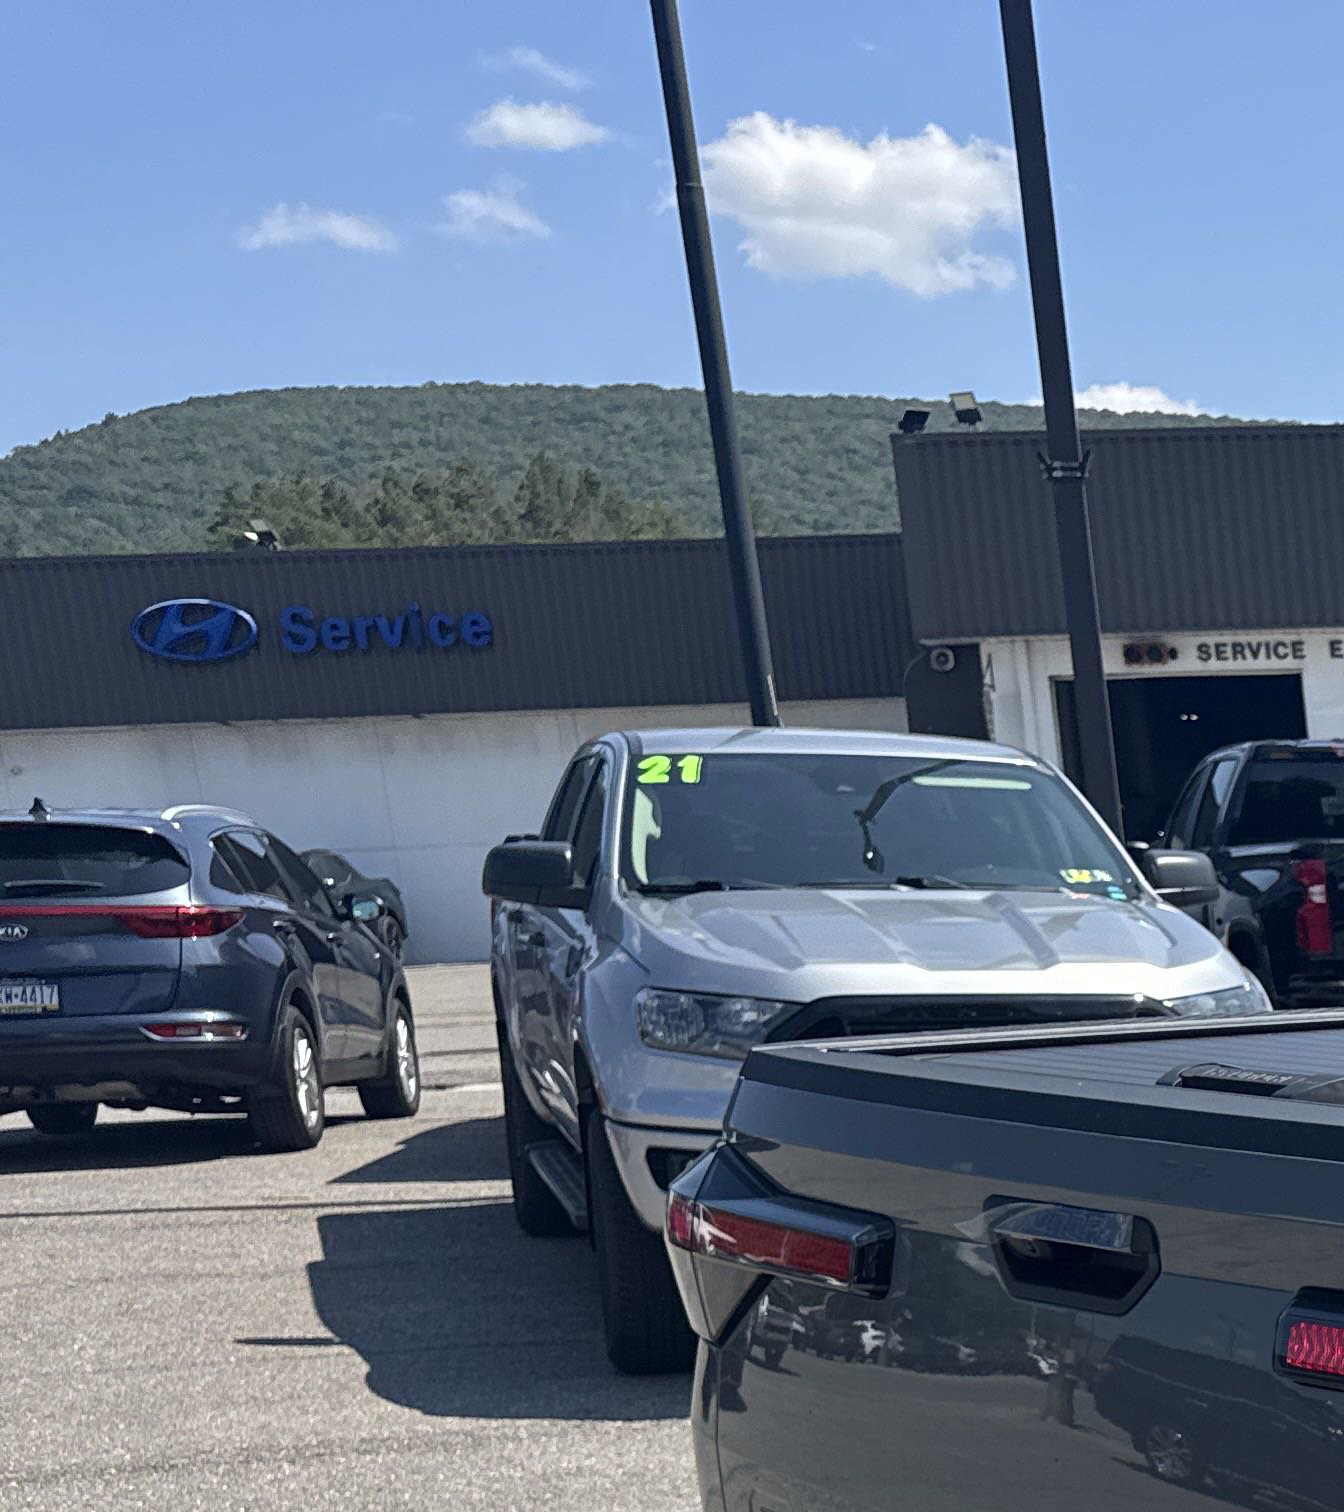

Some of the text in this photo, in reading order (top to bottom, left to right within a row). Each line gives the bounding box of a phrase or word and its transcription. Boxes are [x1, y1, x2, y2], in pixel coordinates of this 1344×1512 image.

[280, 602, 494, 654] Service
[1197, 640, 1307, 662] SERVICE
[637, 755, 703, 783] 21
